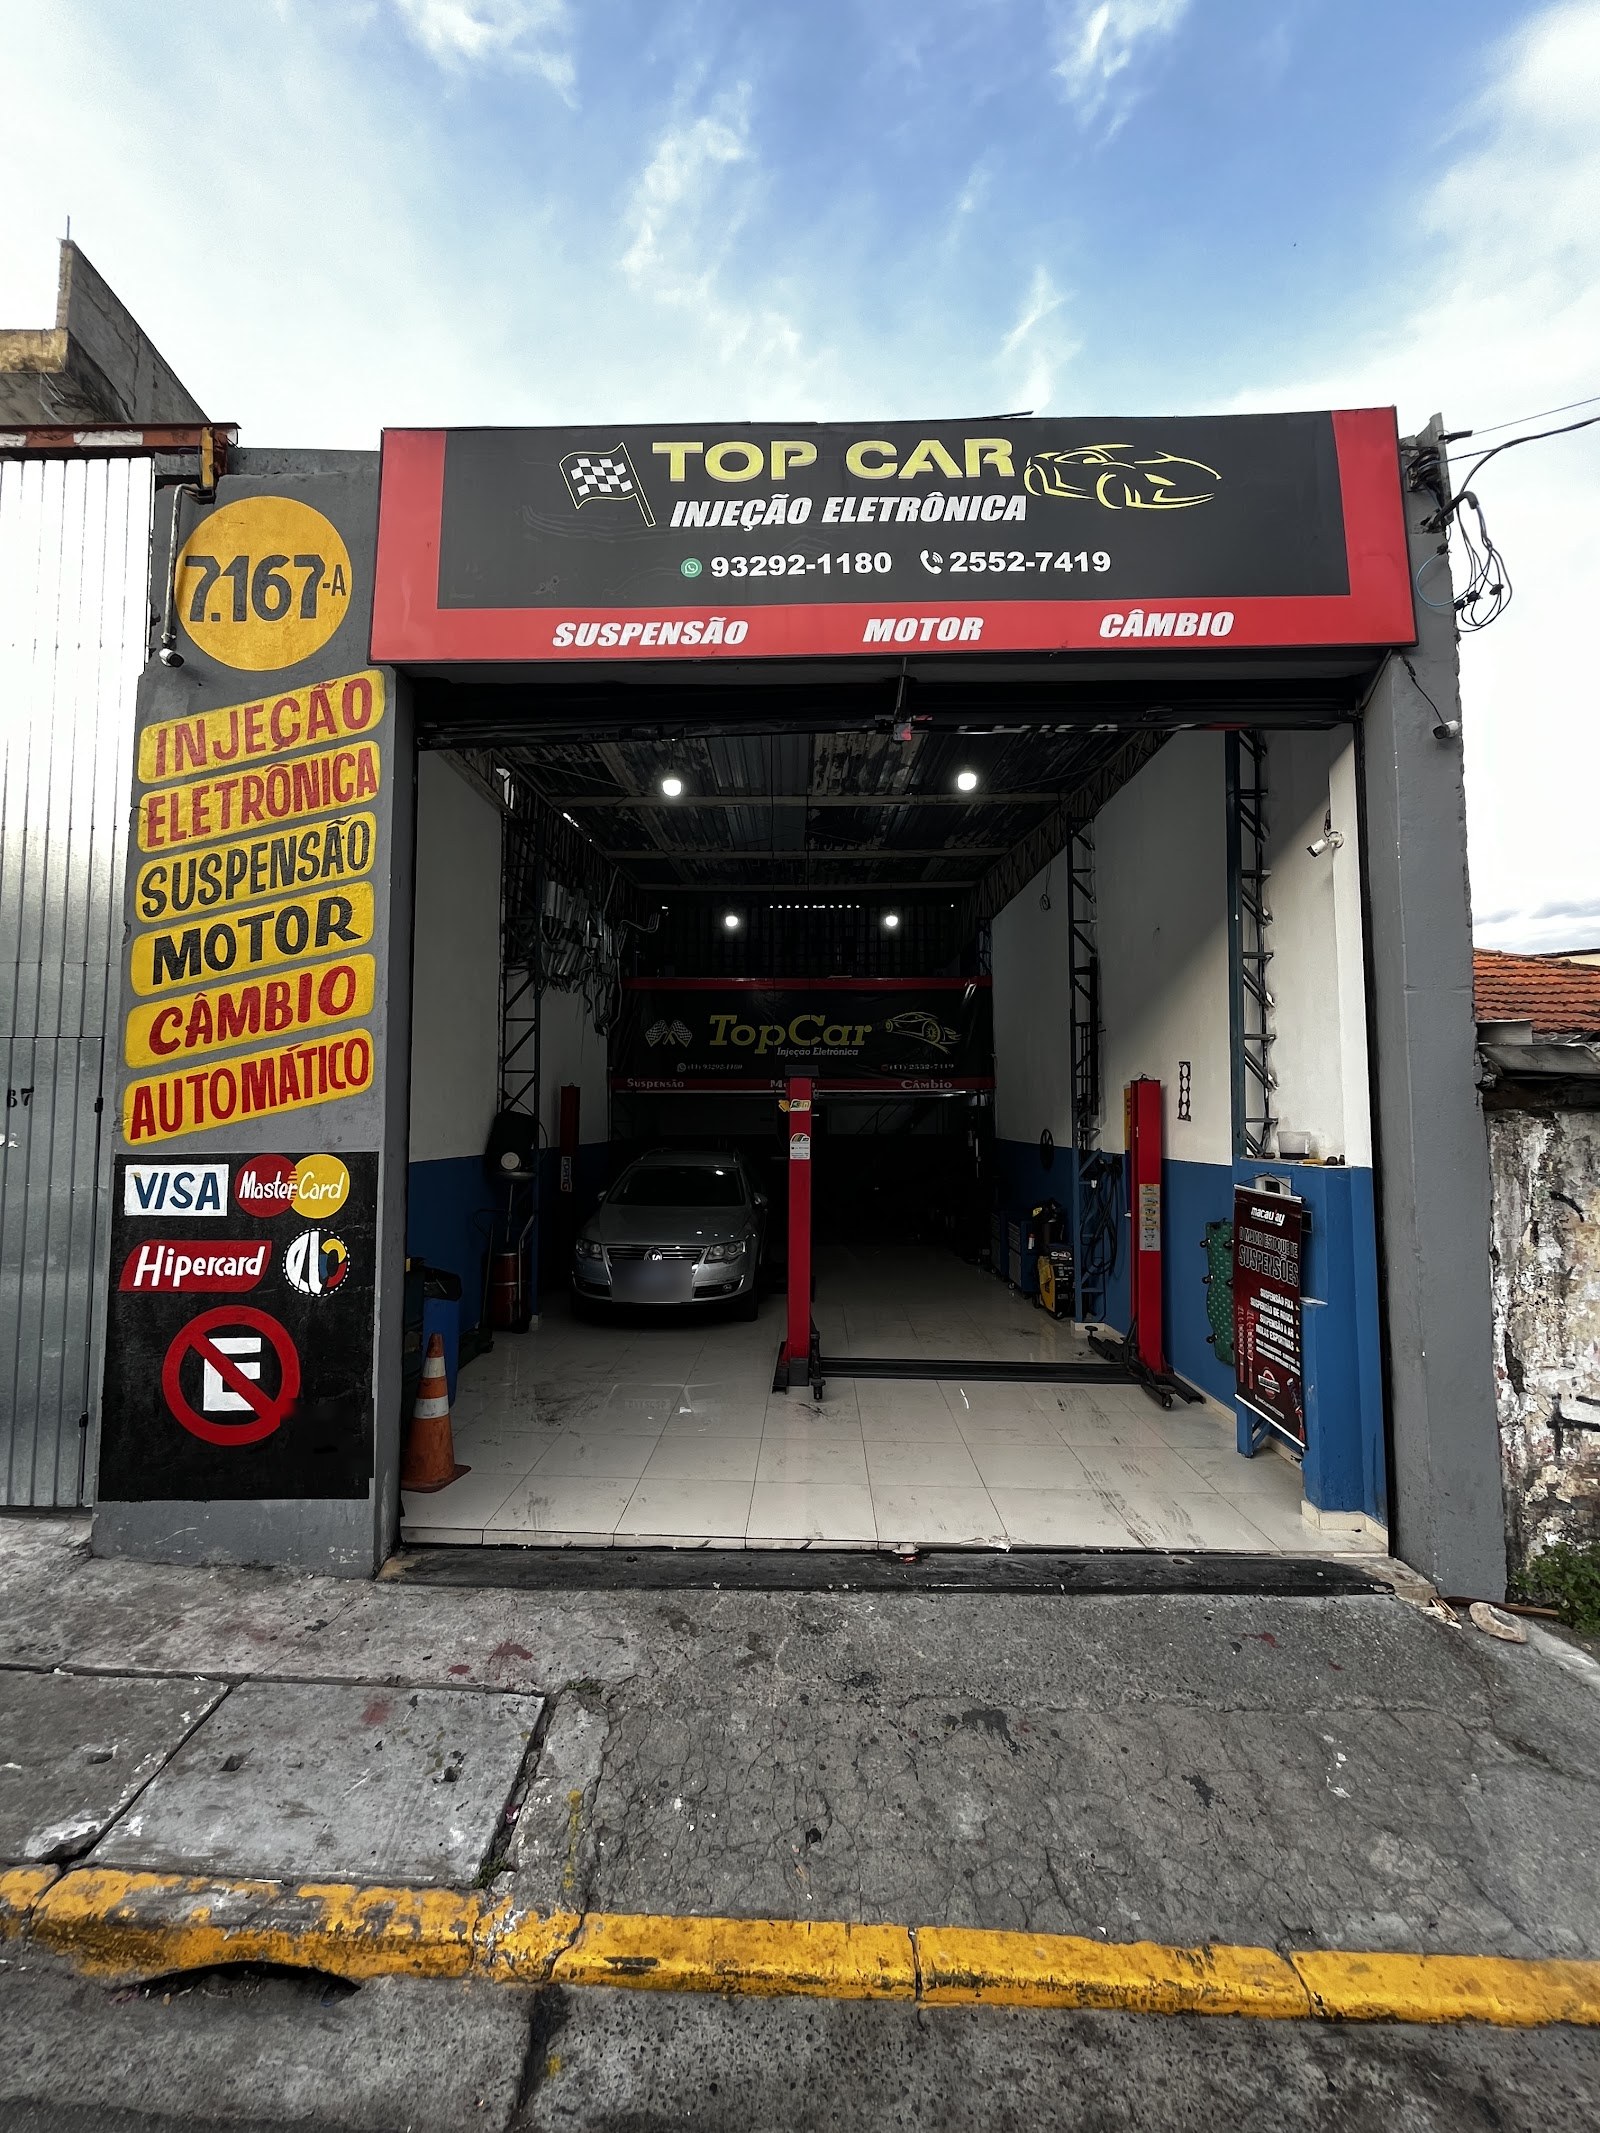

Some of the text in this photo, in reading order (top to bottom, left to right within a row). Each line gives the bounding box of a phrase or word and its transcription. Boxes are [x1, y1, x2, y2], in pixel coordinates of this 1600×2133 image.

[652, 438, 1016, 482] TOP CAR
[670, 491, 1027, 531] INJEÇÃO ELETRÔNICA
[711, 551, 1112, 577] 93292-1180 2552-7419
[552, 608, 1235, 647] SUSPENSÃO MOTOR CÂMBIO
[154, 677, 373, 777] INJEÇÃO
[146, 747, 378, 847] ELETRÔNICA
[141, 817, 371, 918] SUSPENSÃO
[152, 896, 363, 986] MOTOR
[148, 965, 357, 1055] CÂMBIO
[709, 1014, 872, 1055] TopCar
[129, 1037, 370, 1141] AUTOMÁTICO
[131, 1171, 221, 1210] VISA
[133, 1245, 266, 1287] Hipercard
